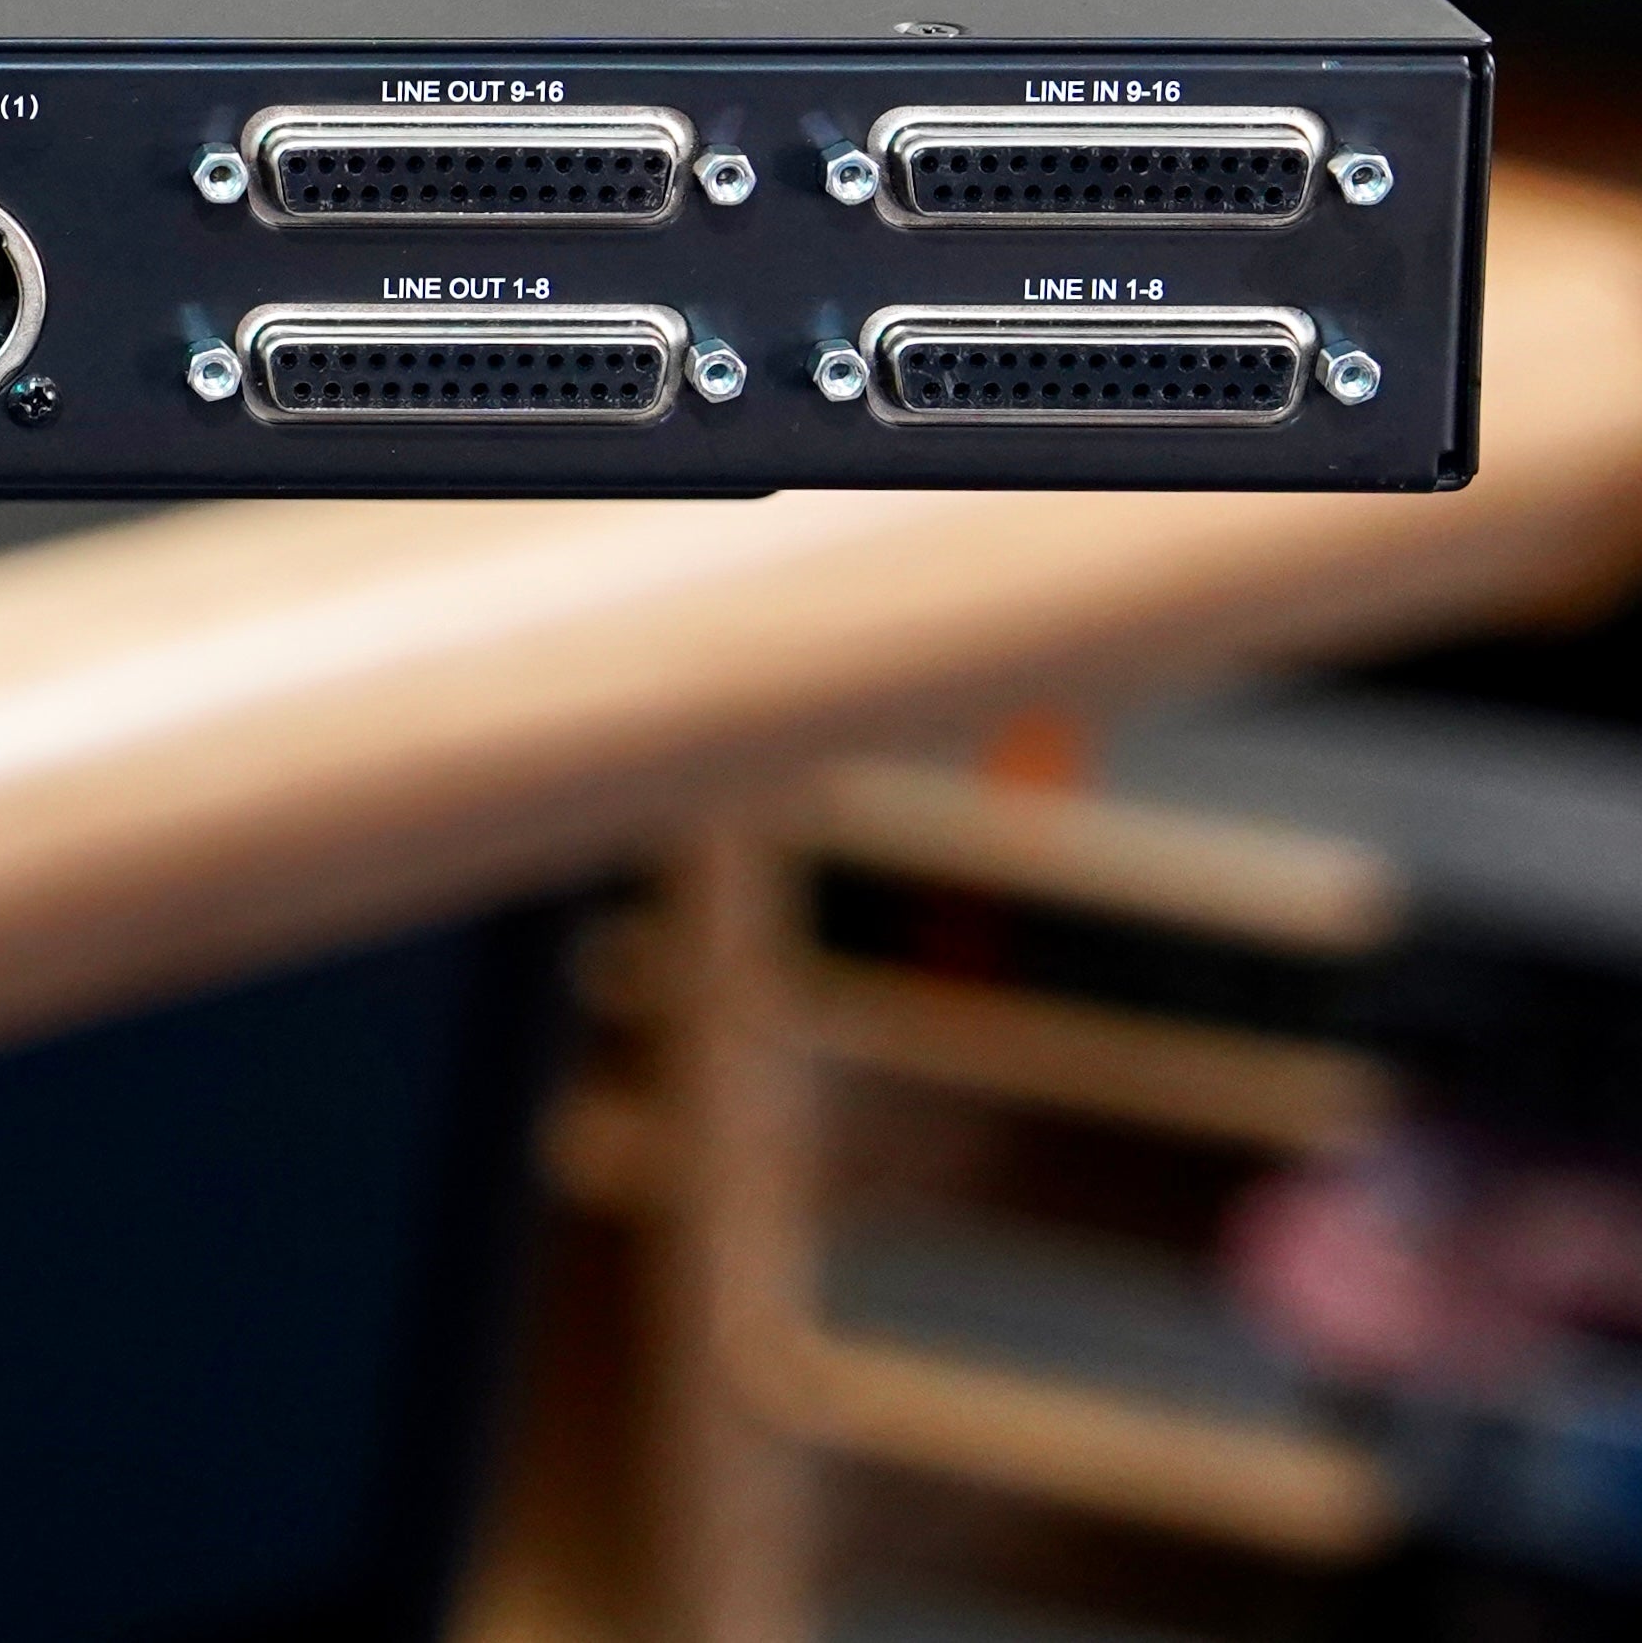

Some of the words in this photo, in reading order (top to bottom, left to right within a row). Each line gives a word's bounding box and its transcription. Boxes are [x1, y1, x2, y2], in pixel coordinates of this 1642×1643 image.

[381, 80, 441, 103] LINE
[447, 80, 506, 103] OUT
[510, 80, 564, 103] 9-16
[1025, 80, 1086, 103] LINE
[1092, 80, 1120, 103] IN
[1126, 80, 1181, 103] 9-16
[0, 93, 39, 120] (1)
[383, 277, 442, 300] LINE
[448, 277, 507, 300] OUT
[512, 277, 550, 300] 1-8
[1023, 278, 1084, 301] LINE
[1091, 278, 1118, 301] IN
[1126, 278, 1164, 301] 1-8
